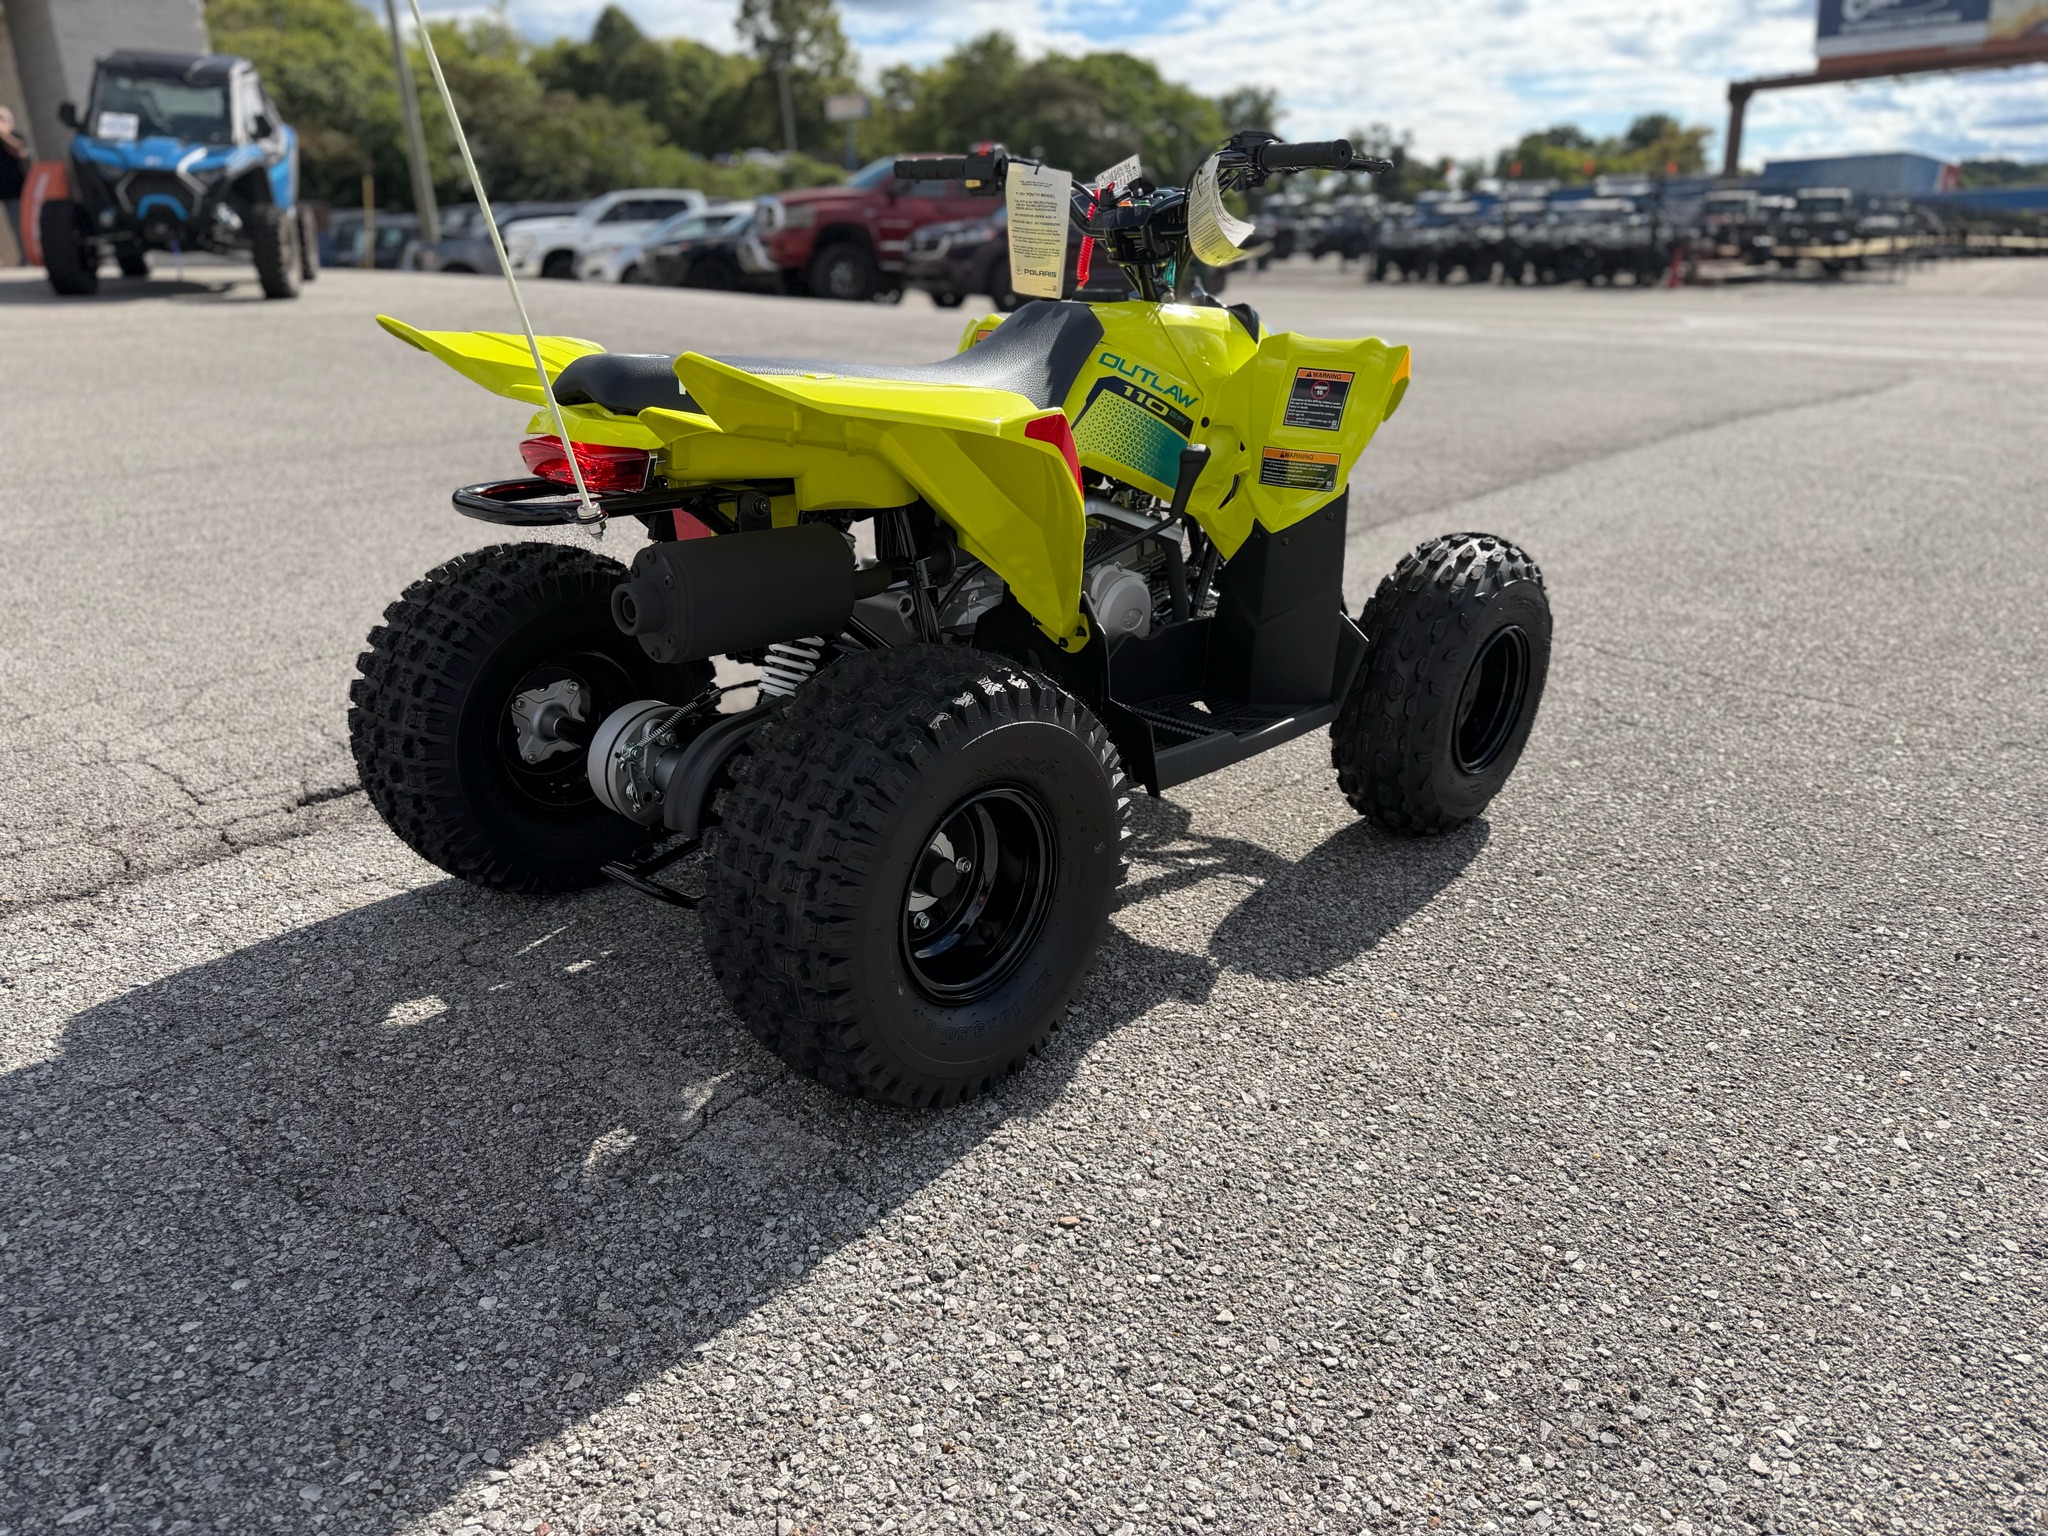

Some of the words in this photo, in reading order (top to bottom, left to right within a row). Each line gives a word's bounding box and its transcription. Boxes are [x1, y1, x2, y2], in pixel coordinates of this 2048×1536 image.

[1024, 268, 1057, 278] POLARIS
[1098, 352, 1200, 408] OUTLAW
[1312, 371, 1342, 380] WARNING
[1124, 384, 1170, 416] 110
[1169, 410, 1187, 426] EFI
[1284, 452, 1314, 460] WARNING
